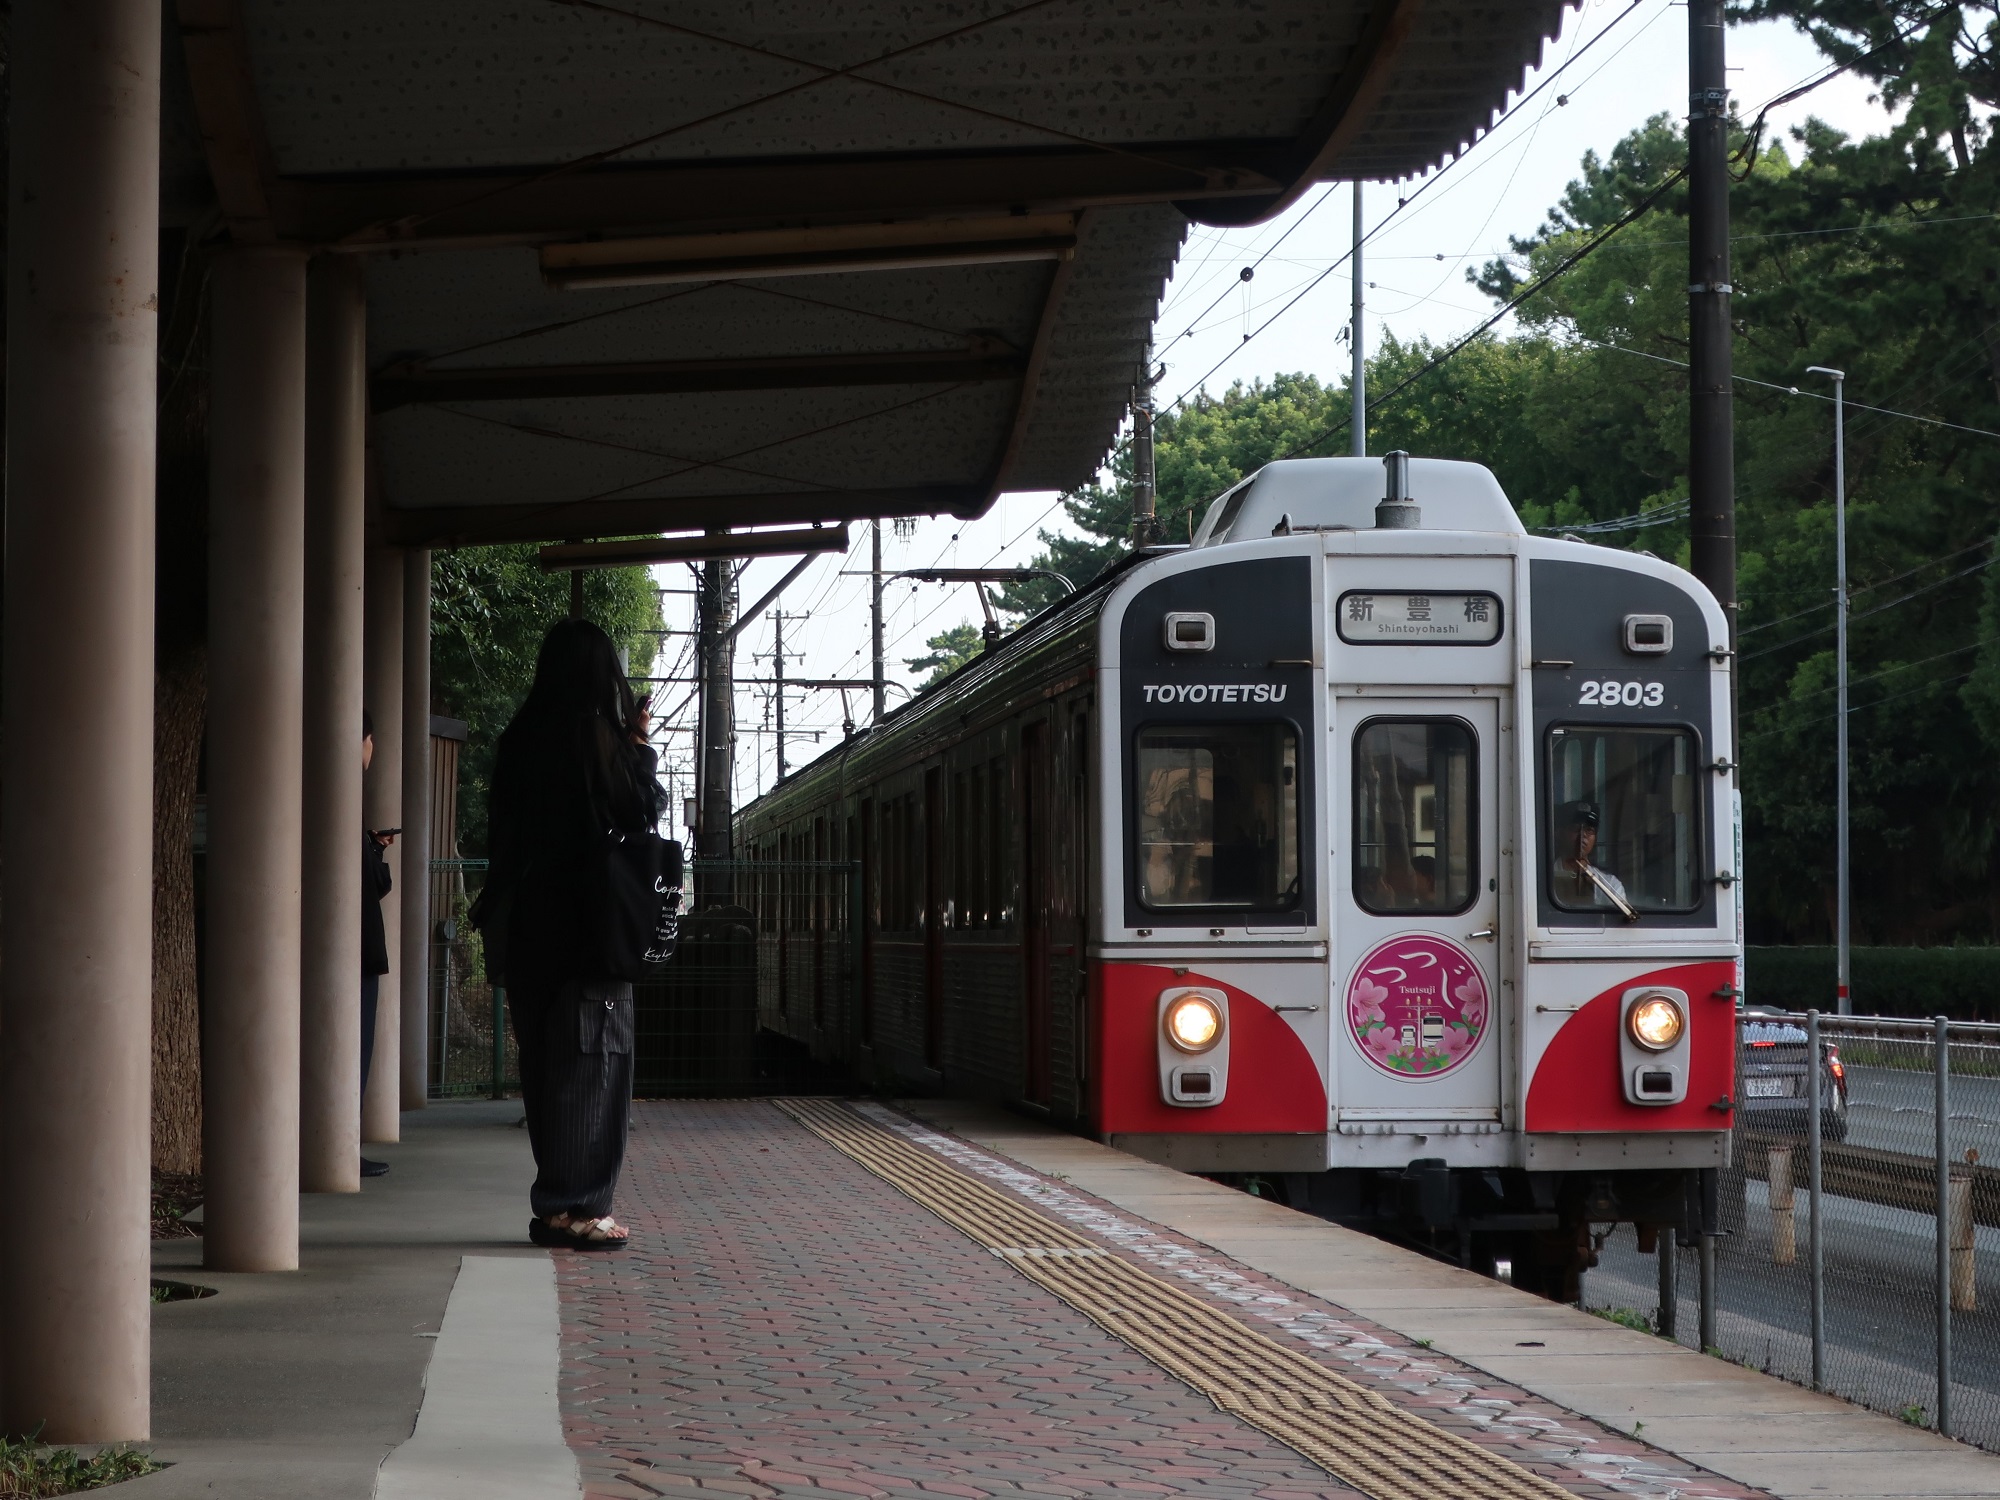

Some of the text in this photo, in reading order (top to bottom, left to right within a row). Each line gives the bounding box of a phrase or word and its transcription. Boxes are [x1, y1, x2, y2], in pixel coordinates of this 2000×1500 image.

[1349, 596, 1490, 623] 新豊橋
[1378, 624, 1459, 635] Shintoyohashi
[1142, 684, 1287, 704] TOYOTETSU
[1578, 680, 1666, 707] 2803
[1367, 951, 1467, 1010] つつじ
[1399, 985, 1436, 995] Tsutsuji
